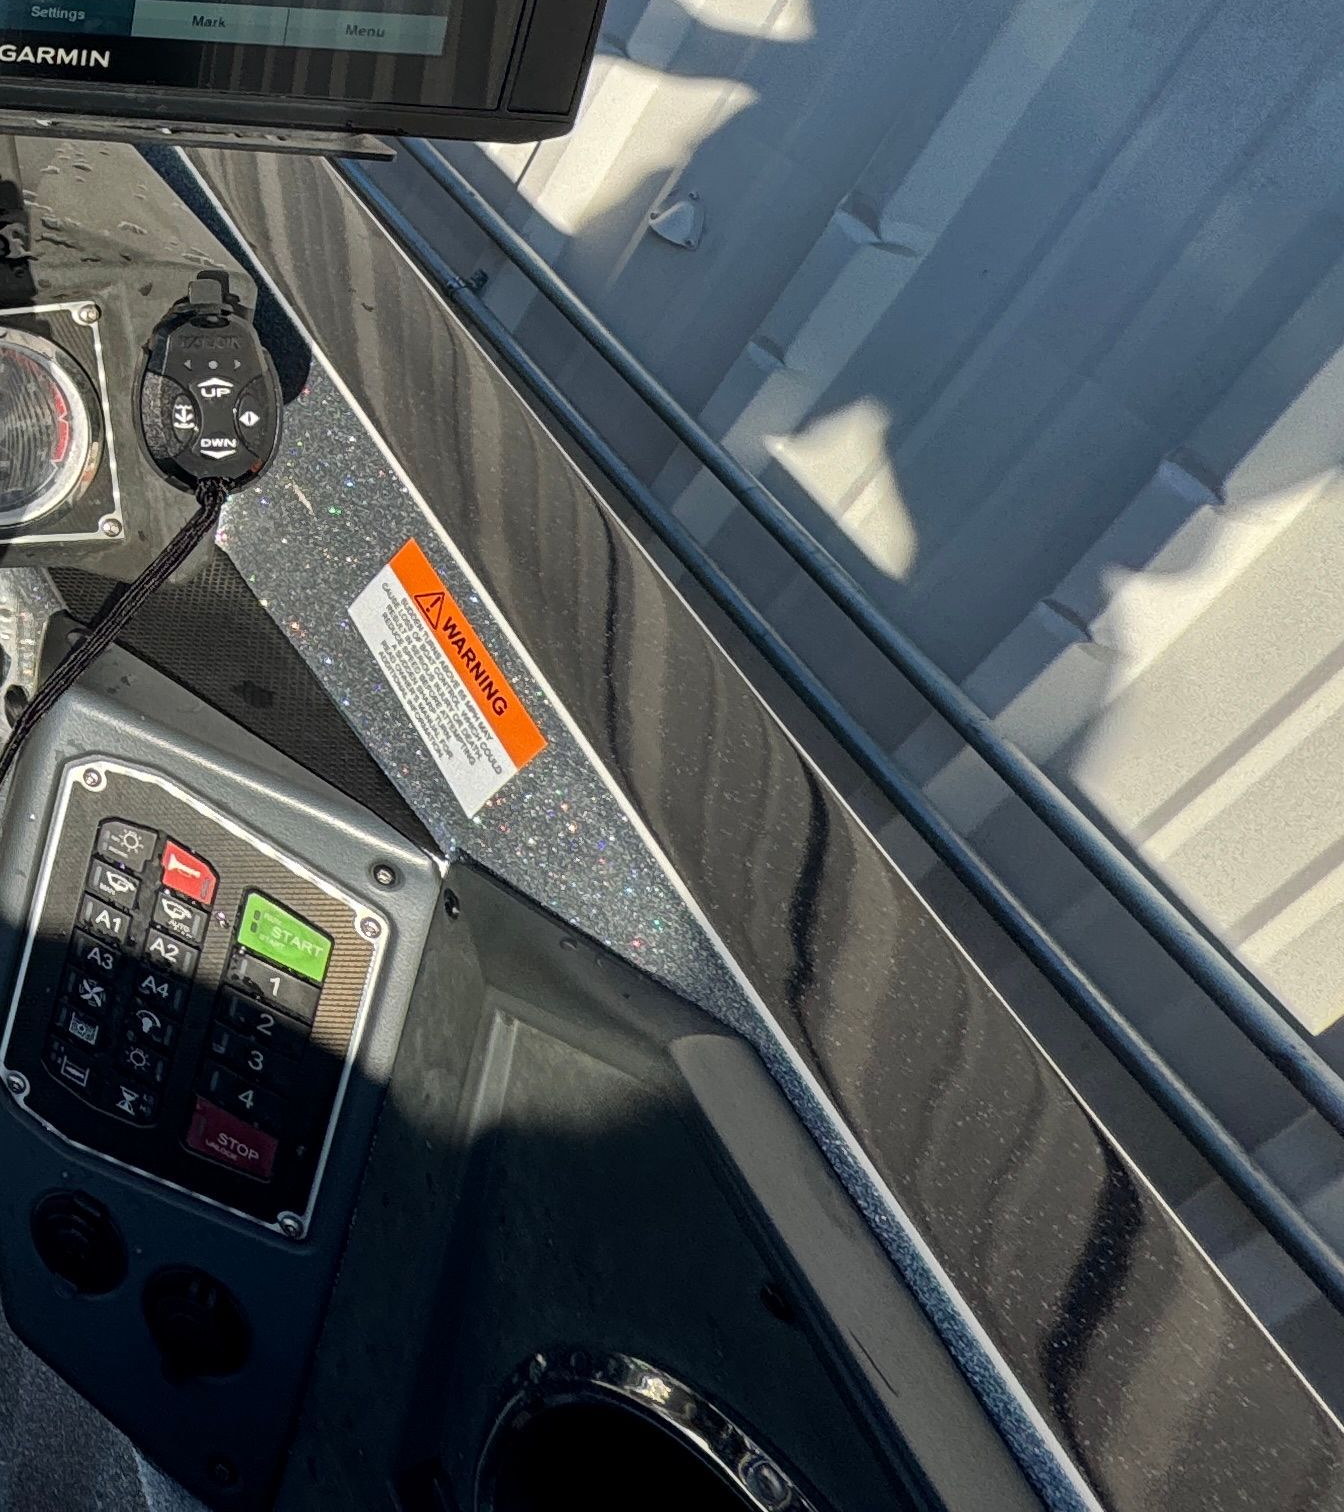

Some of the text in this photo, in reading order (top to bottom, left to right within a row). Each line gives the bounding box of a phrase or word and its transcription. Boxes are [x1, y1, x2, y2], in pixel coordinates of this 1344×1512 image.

[30, 4, 86, 22] Settings
[191, 14, 226, 28] Mark
[344, 24, 386, 39] Menu
[200, 387, 231, 398] UP
[200, 438, 237, 448] DWN
[442, 616, 508, 716] WARNING
[478, 739, 504, 776] COULD
[95, 909, 122, 934] A1
[149, 937, 180, 964] A2
[270, 925, 324, 959] START
[87, 947, 113, 970] A3
[141, 975, 170, 999] A4
[269, 976, 282, 997] 1
[256, 1013, 275, 1036] 2
[247, 1050, 264, 1071] 3
[238, 1089, 254, 1110] 4
[217, 1132, 260, 1162] STOP
